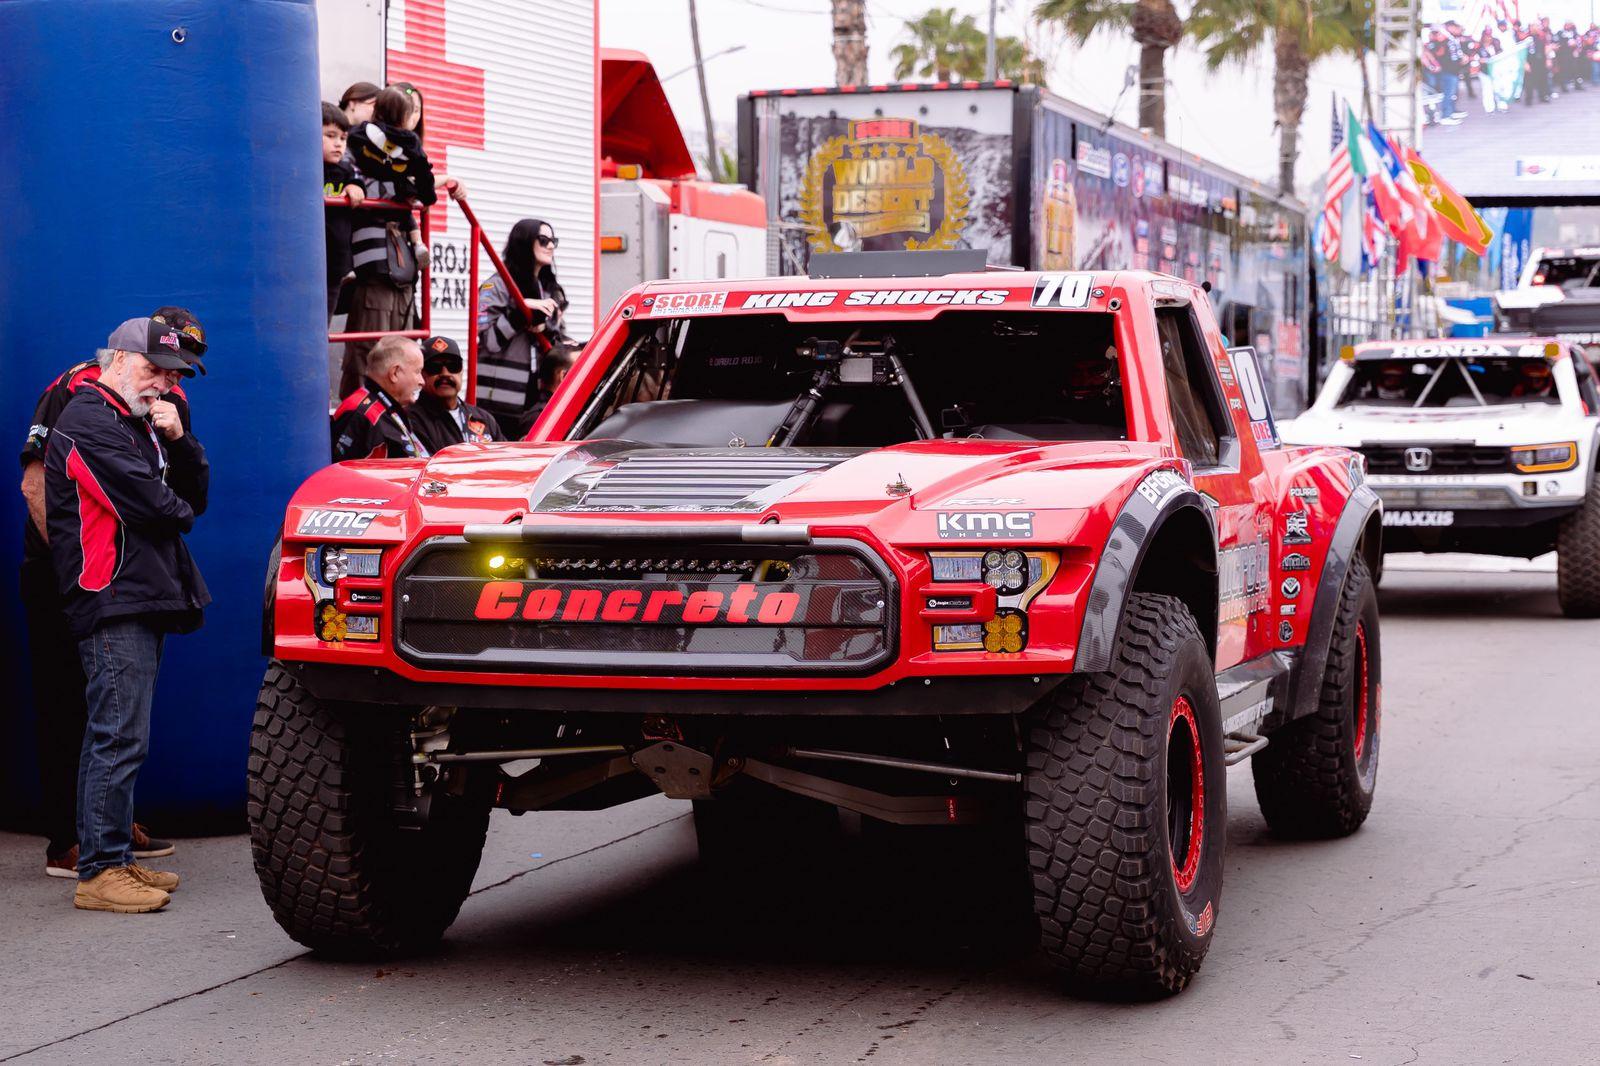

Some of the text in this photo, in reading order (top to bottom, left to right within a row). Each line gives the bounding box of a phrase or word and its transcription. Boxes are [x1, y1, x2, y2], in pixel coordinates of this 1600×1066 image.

[741, 290, 1009, 309] KING SHOCKS
[1035, 274, 1092, 307] 70
[656, 293, 724, 308] SCORE
[1390, 344, 1510, 358] HONDA
[304, 510, 380, 529] KMC
[938, 513, 1031, 530] KMC
[1383, 511, 1454, 526] MAXXIS
[473, 581, 801, 623] Concreto
